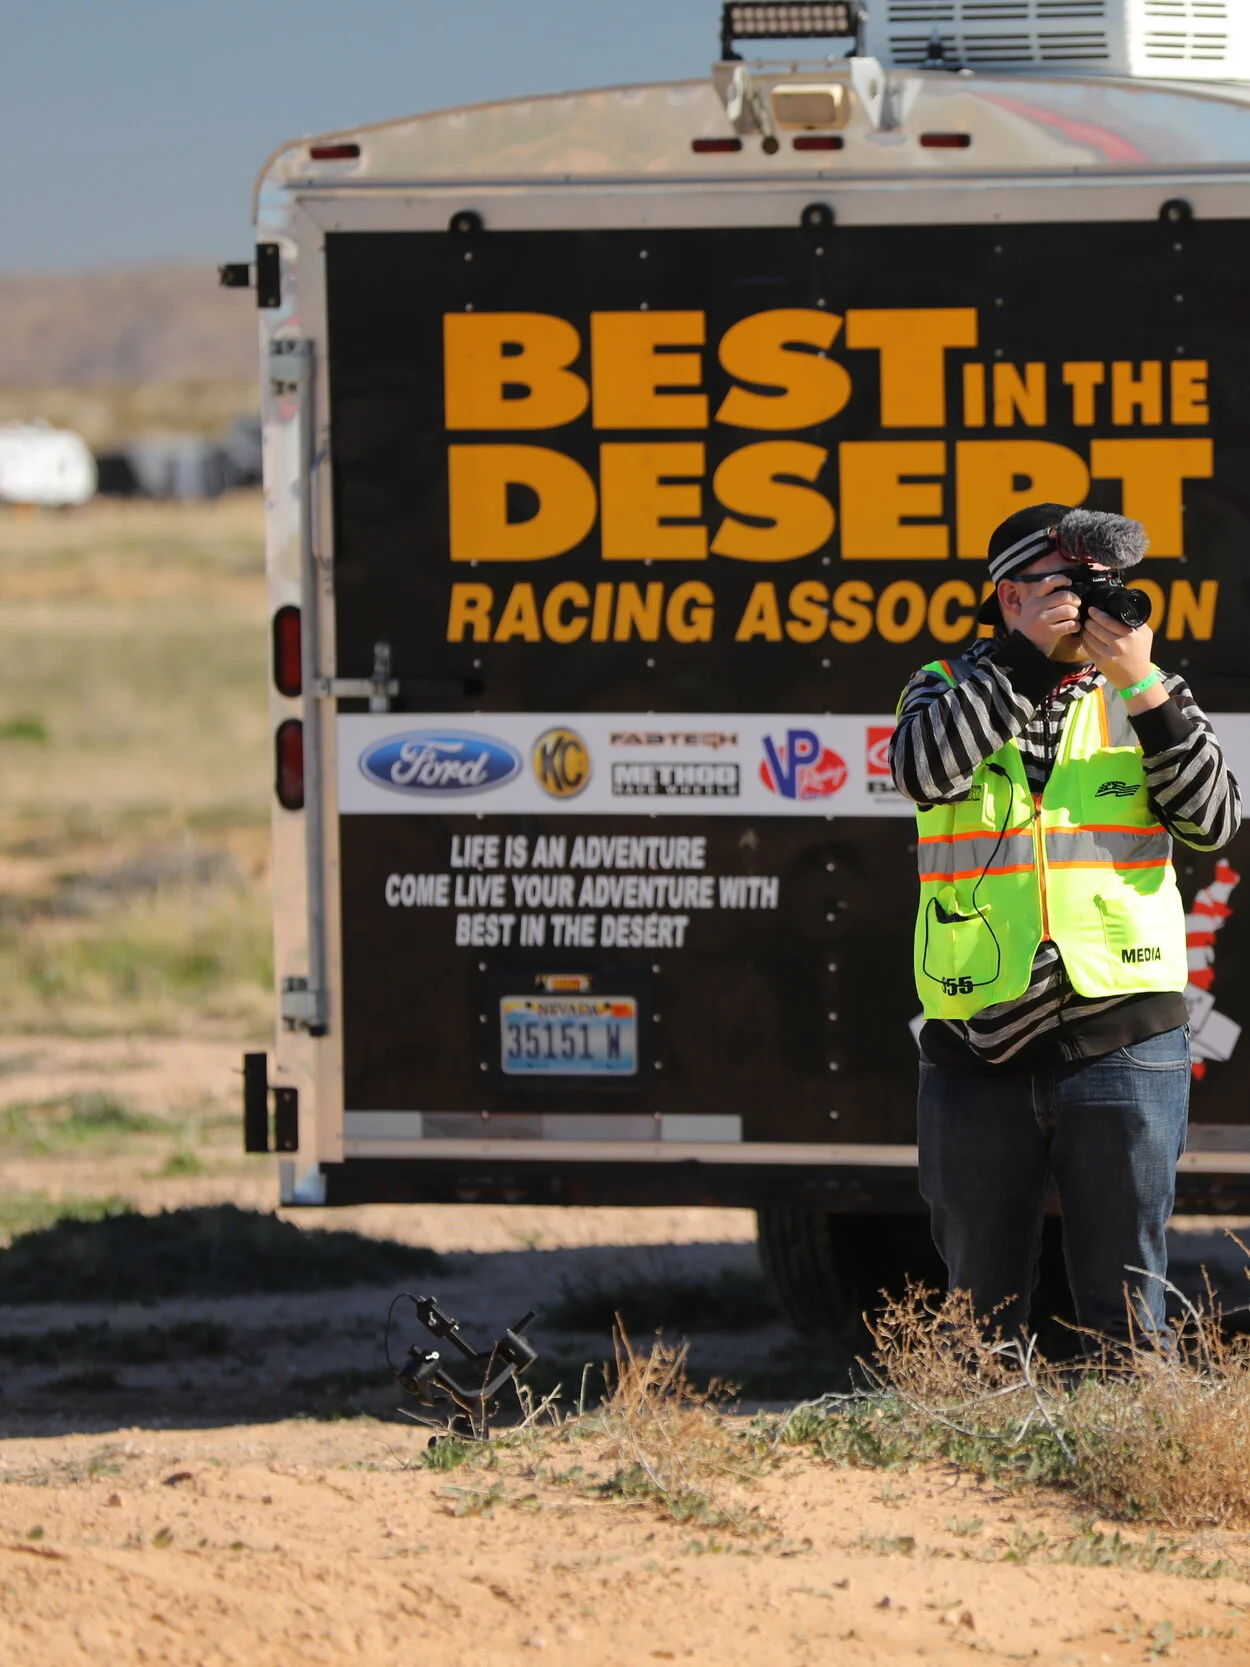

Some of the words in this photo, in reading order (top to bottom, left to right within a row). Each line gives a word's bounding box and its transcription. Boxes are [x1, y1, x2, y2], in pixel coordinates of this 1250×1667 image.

[443, 308, 979, 432] BEST
[963, 362, 1047, 428] IN
[1062, 360, 1211, 427] THE
[448, 438, 1215, 563] DESERT
[446, 582, 716, 644] RACING
[390, 741, 490, 786] Ford
[541, 735, 583, 791] KC
[613, 763, 739, 785] METHOD
[762, 730, 820, 799] VP
[450, 835, 500, 868] LIFE
[504, 835, 528, 868] IS
[531, 835, 567, 868] AN
[569, 836, 707, 869] ADVENTURE
[385, 874, 450, 907] COME
[454, 875, 507, 908] LIVE
[512, 876, 575, 908] YOUR
[578, 876, 715, 908] ADVENTURE
[719, 877, 779, 909] WITH
[455, 914, 516, 947] BEST
[520, 915, 546, 947] IN
[550, 915, 596, 947] THE
[600, 915, 690, 948] DESERT
[1121, 947, 1161, 963] MEDIA
[537, 1003, 599, 1018] NEVADA
[507, 1021, 594, 1061] 35151
